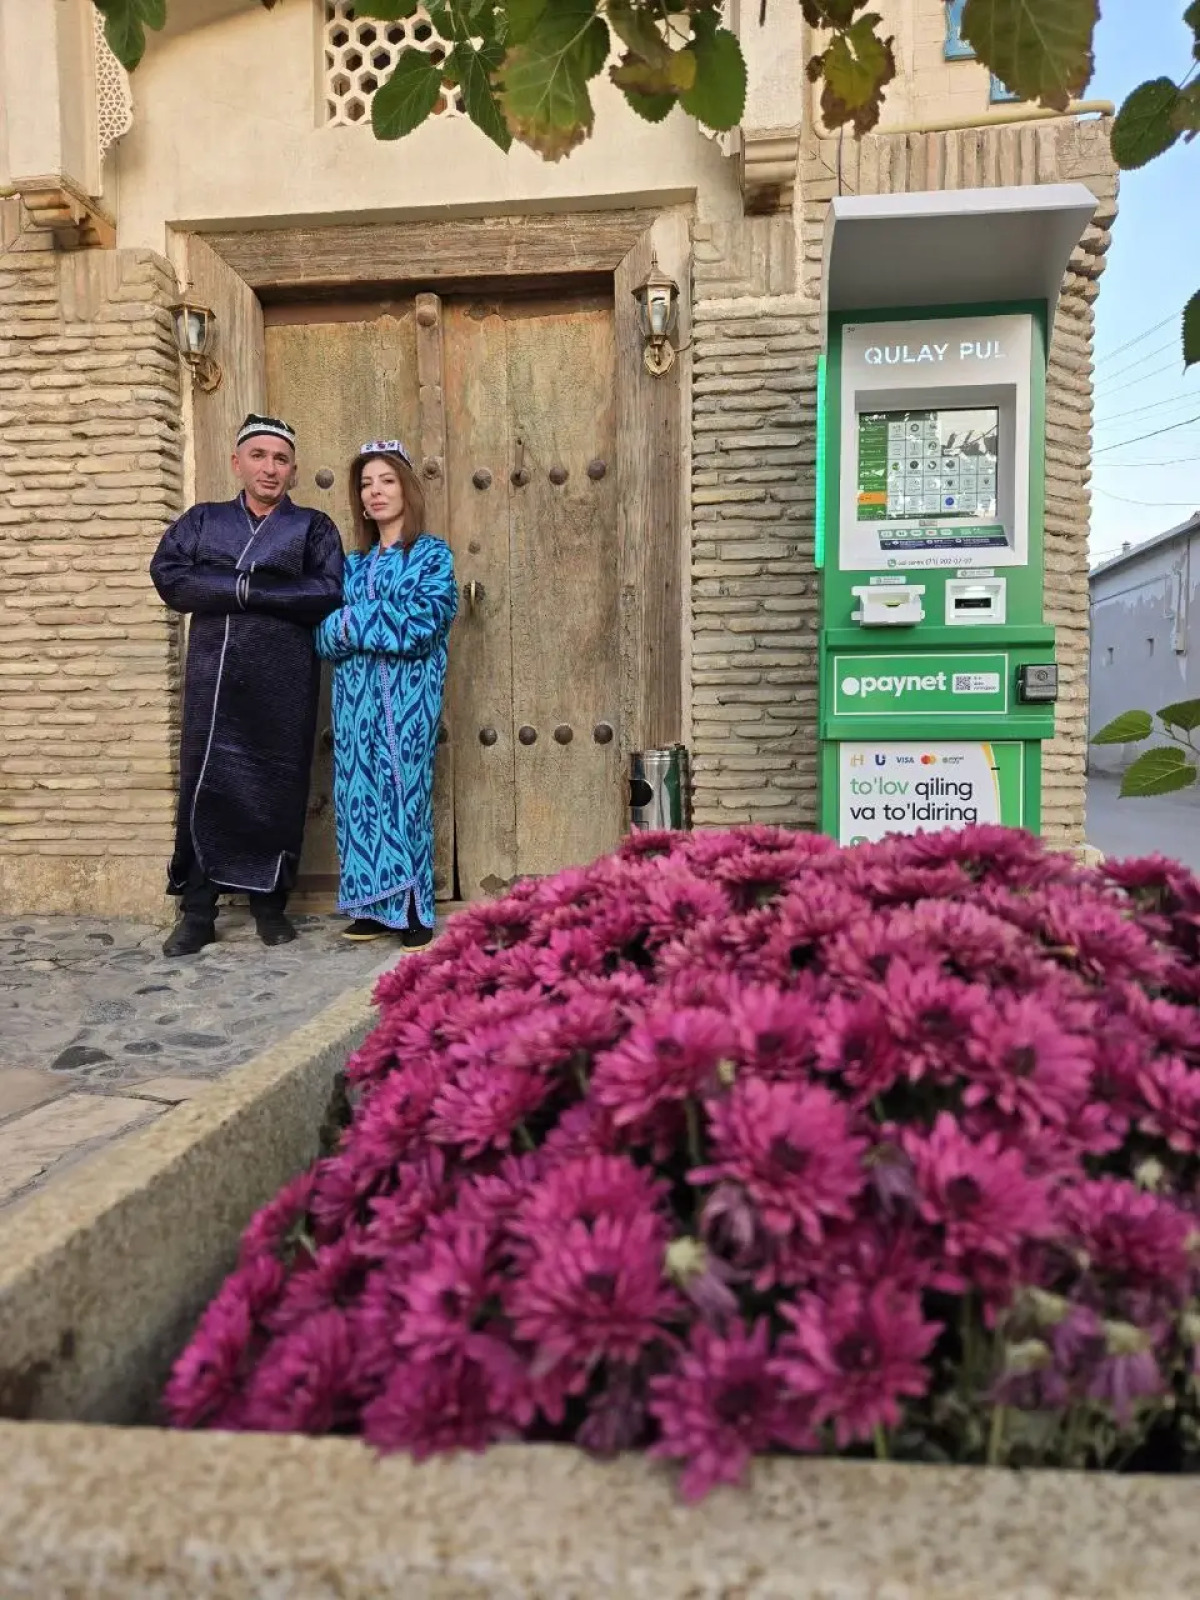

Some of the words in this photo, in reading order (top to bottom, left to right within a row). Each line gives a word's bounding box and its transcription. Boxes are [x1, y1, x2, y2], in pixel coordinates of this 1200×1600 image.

[864, 343, 950, 365] QULAY
[959, 340, 1007, 361] PUL
[861, 671, 947, 698] paynet
[896, 755, 915, 765] VISA
[850, 777, 909, 796] to'lov
[914, 777, 973, 801] qiling
[850, 806, 876, 821] va
[882, 802, 978, 825] to'ldiring
